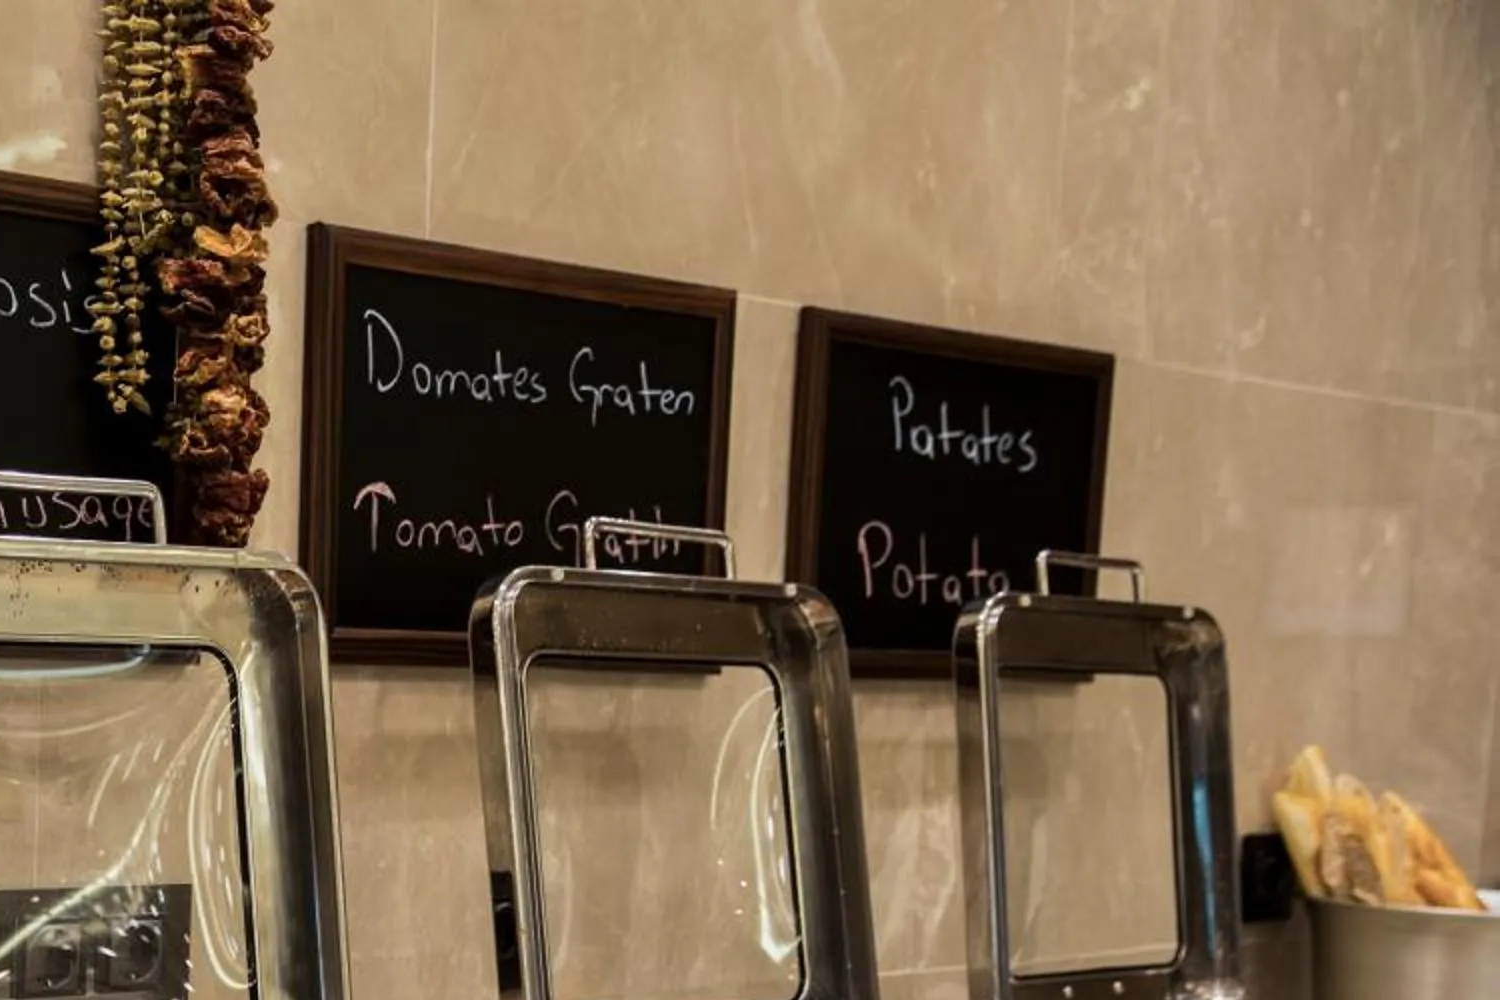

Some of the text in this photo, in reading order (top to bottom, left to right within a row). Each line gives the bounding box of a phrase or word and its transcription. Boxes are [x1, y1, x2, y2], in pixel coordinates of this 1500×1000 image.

[363, 309, 696, 427] Domates Graten
[889, 375, 1038, 472] Patates
[353, 481, 524, 555] Tomato
[857, 520, 1011, 605] Potato
